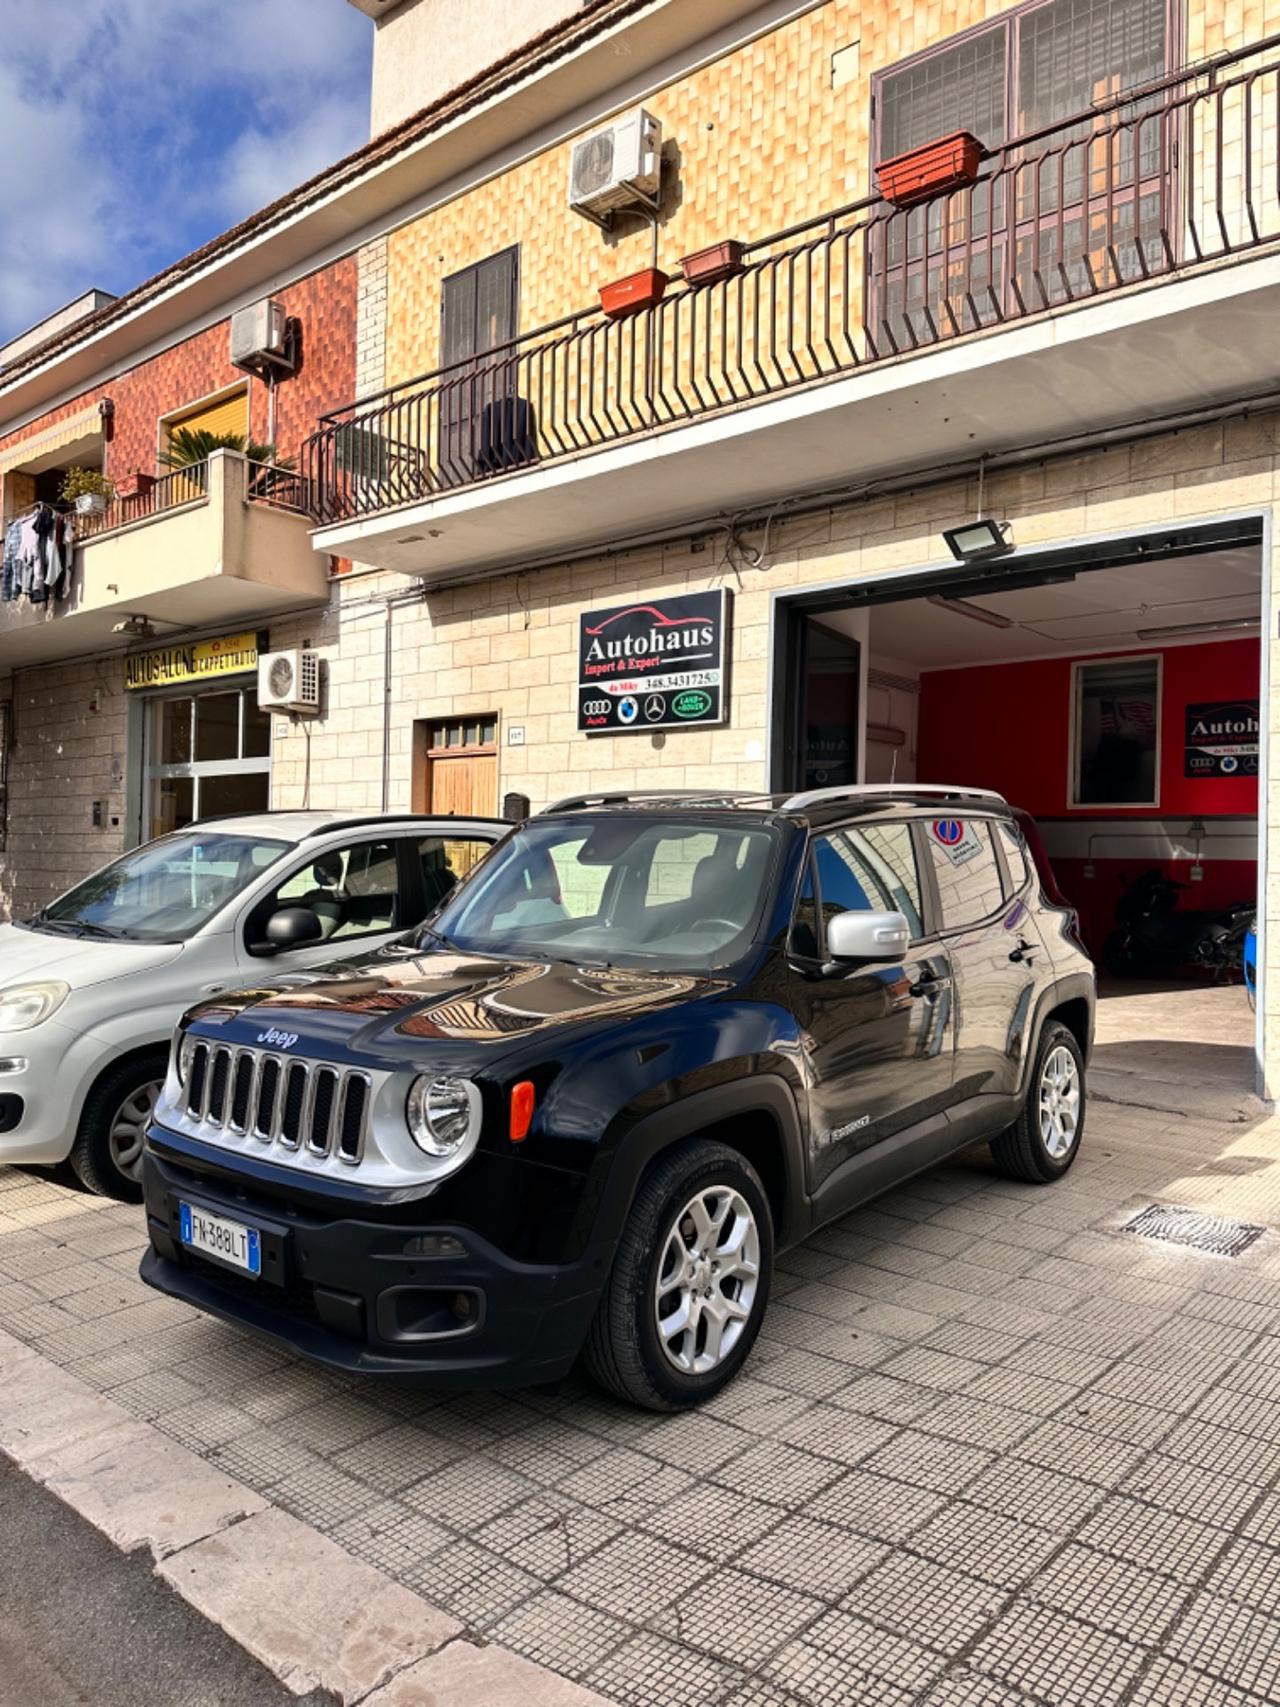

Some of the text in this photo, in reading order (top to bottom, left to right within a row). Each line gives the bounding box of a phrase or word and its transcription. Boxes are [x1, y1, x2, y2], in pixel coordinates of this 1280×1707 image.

[585, 626, 713, 661] Autohaus
[126, 647, 197, 685] AUTOSALONE
[585, 656, 660, 676] Import & Export
[257, 1027, 298, 1048] Jeep
